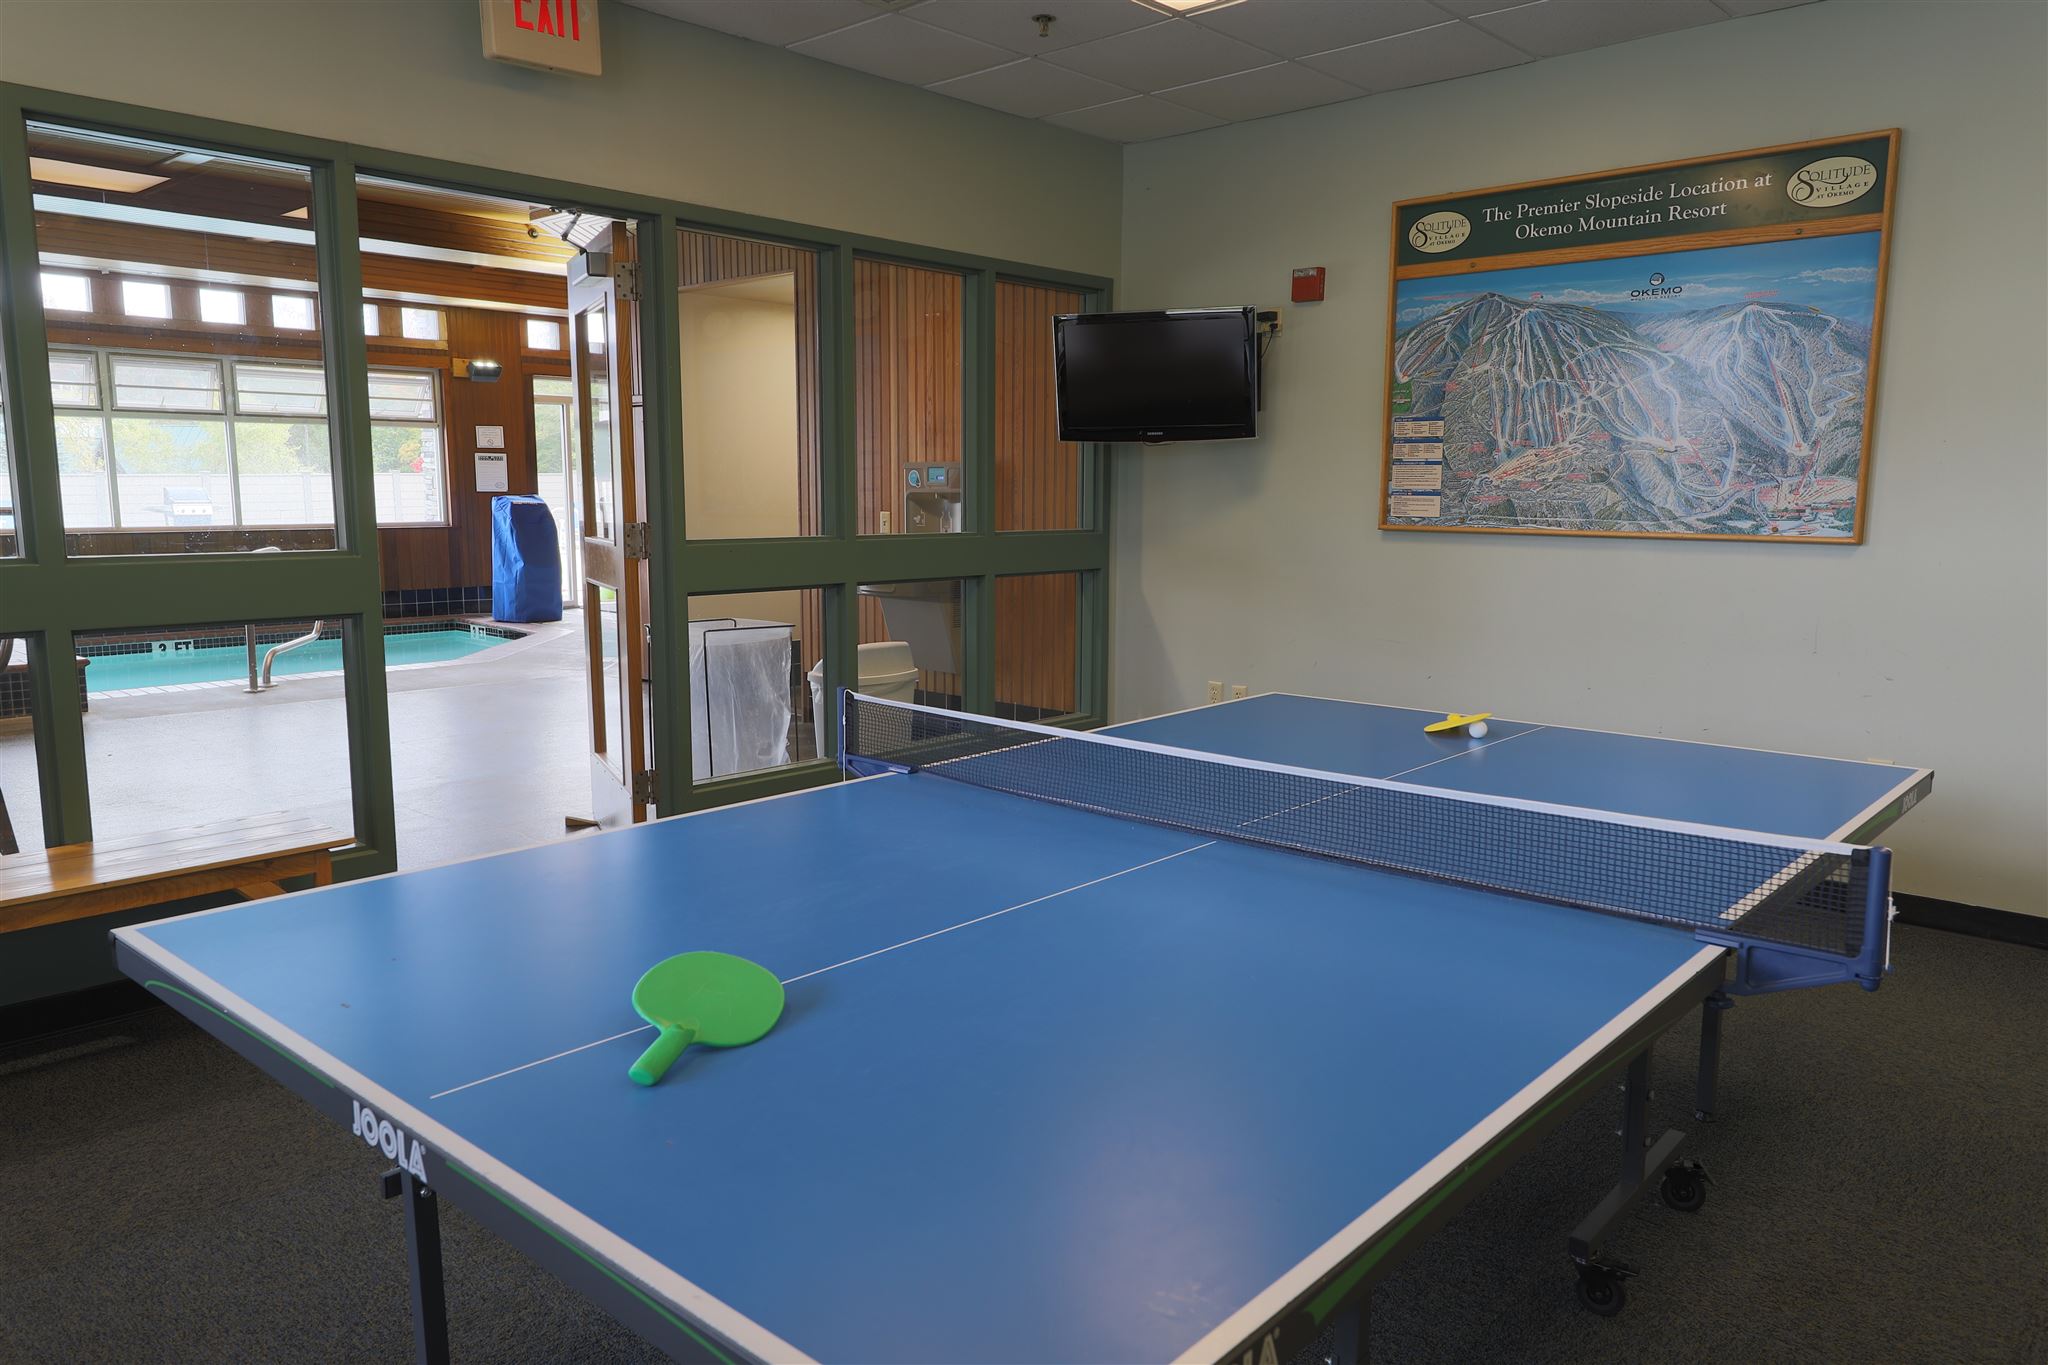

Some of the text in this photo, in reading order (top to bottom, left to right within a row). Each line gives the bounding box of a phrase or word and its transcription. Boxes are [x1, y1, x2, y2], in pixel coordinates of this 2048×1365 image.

[513, 0, 580, 41] EXIT
[1482, 173, 1773, 223] The Premier Slopeside Location at
[1792, 164, 1872, 201] SOLITUDE
[1816, 181, 1869, 192] VILLAGE
[1412, 219, 1467, 248] SOLITUDE
[1429, 233, 1465, 241] VILLAGE
[1515, 202, 1728, 239] Okemo Mountain Resort
[1630, 286, 1683, 297] OKEMO
[352, 1099, 428, 1184] JOOLA
